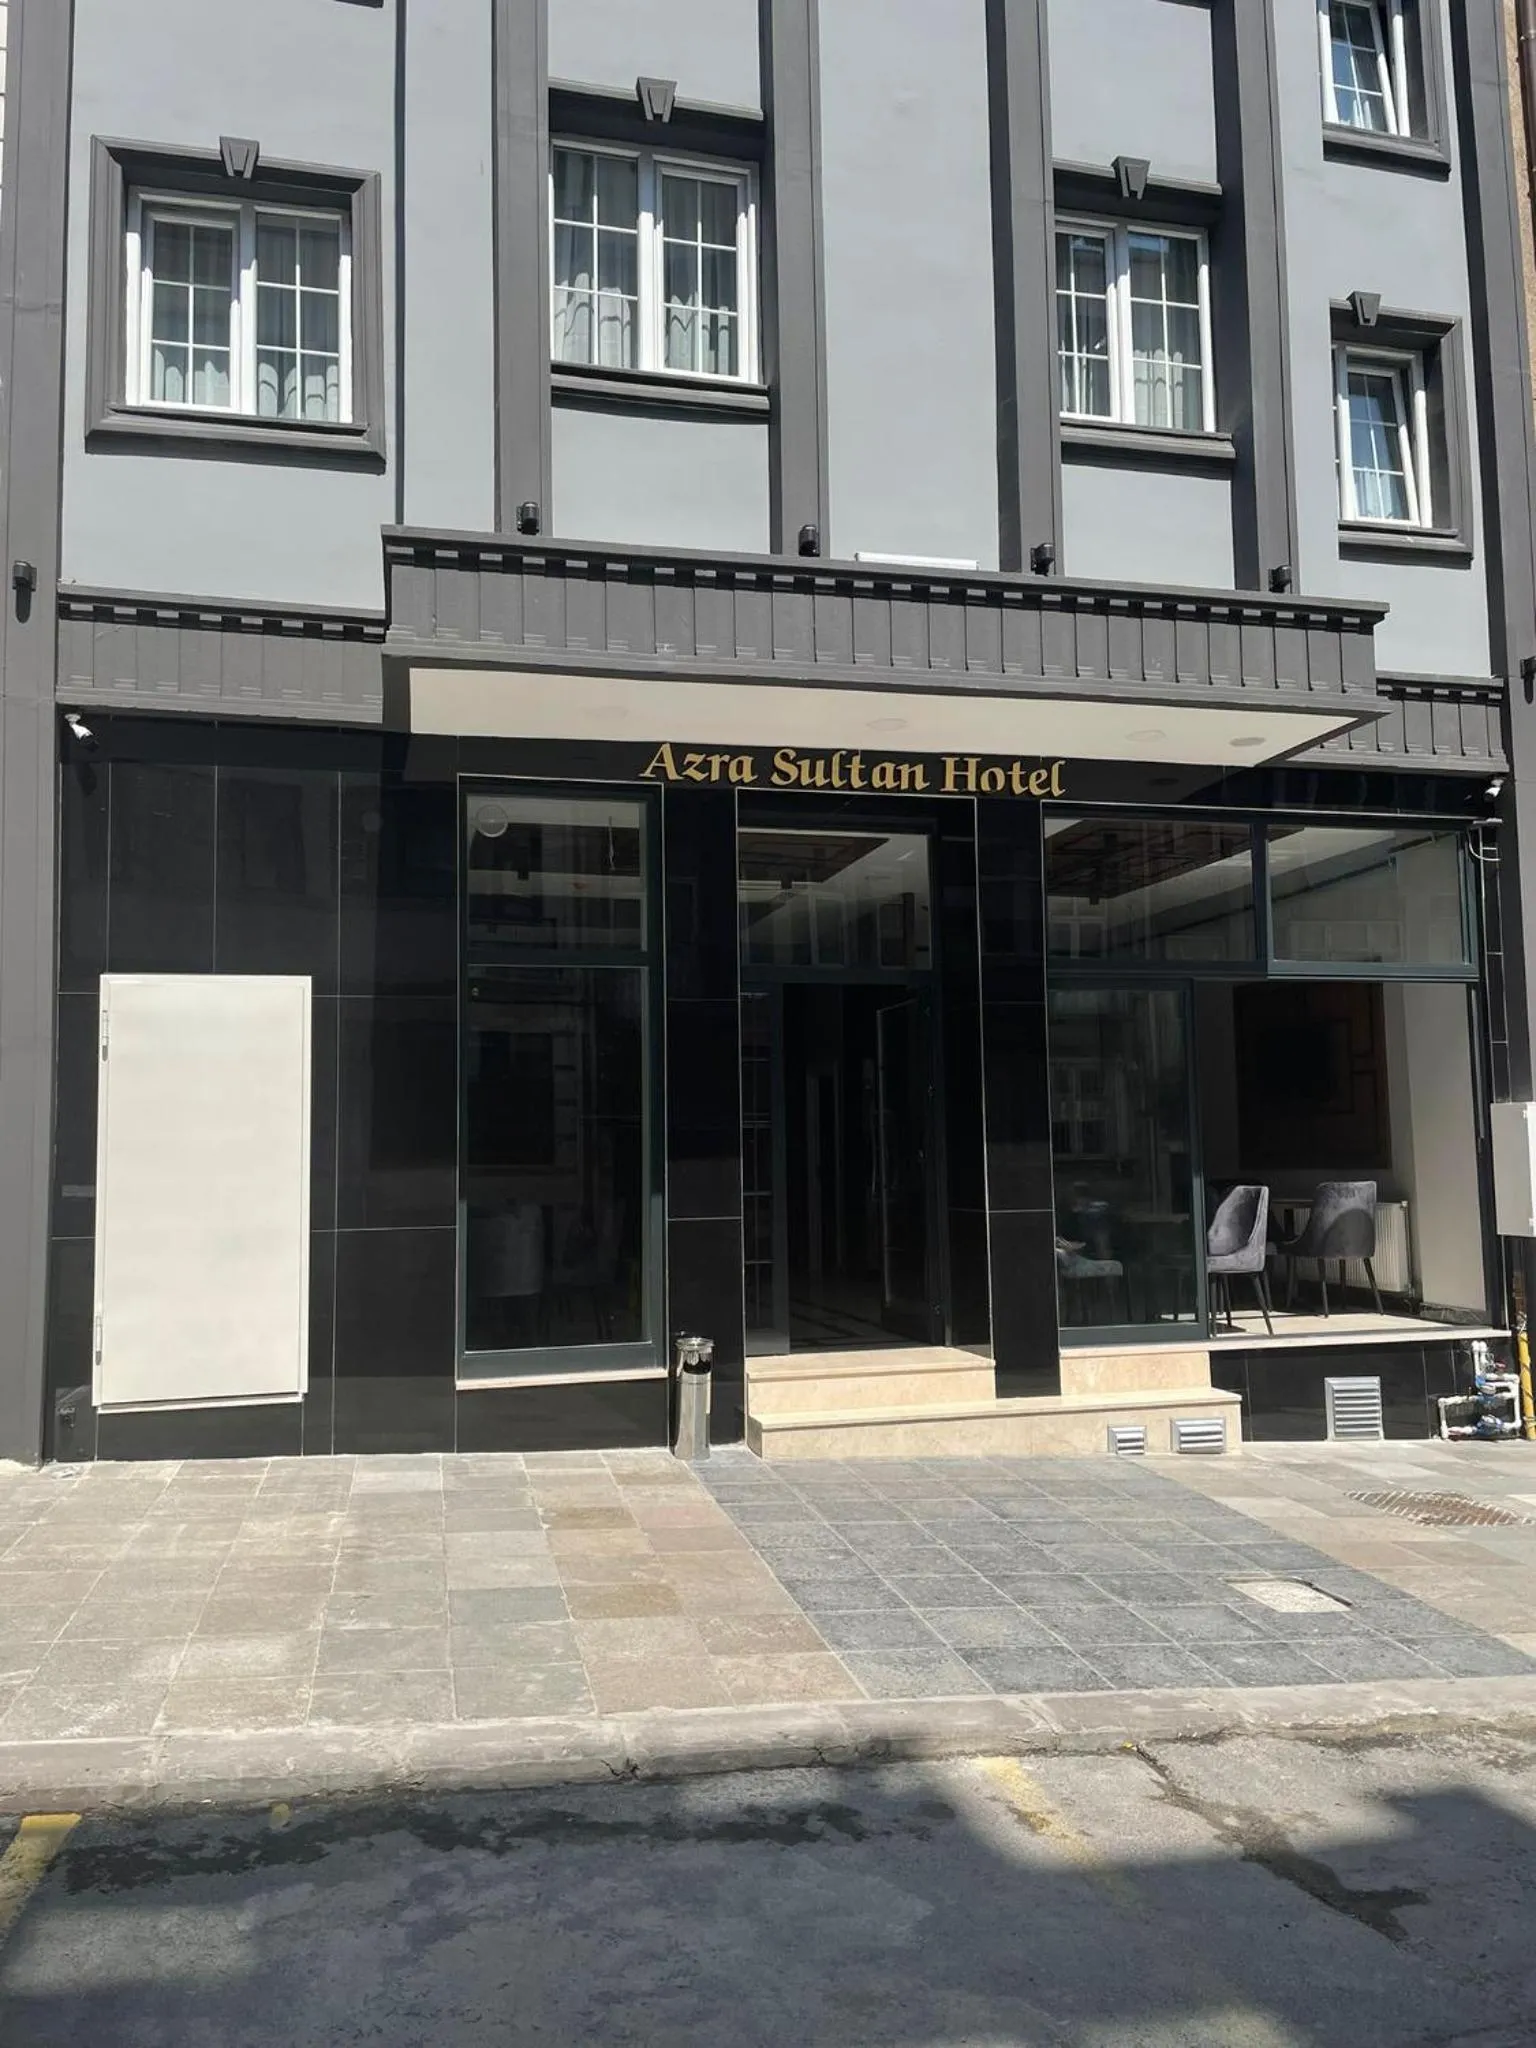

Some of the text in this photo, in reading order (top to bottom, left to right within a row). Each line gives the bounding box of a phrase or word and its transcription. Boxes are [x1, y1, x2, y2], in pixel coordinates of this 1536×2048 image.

[638, 742, 1067, 798] Azra Sultan Hotel
